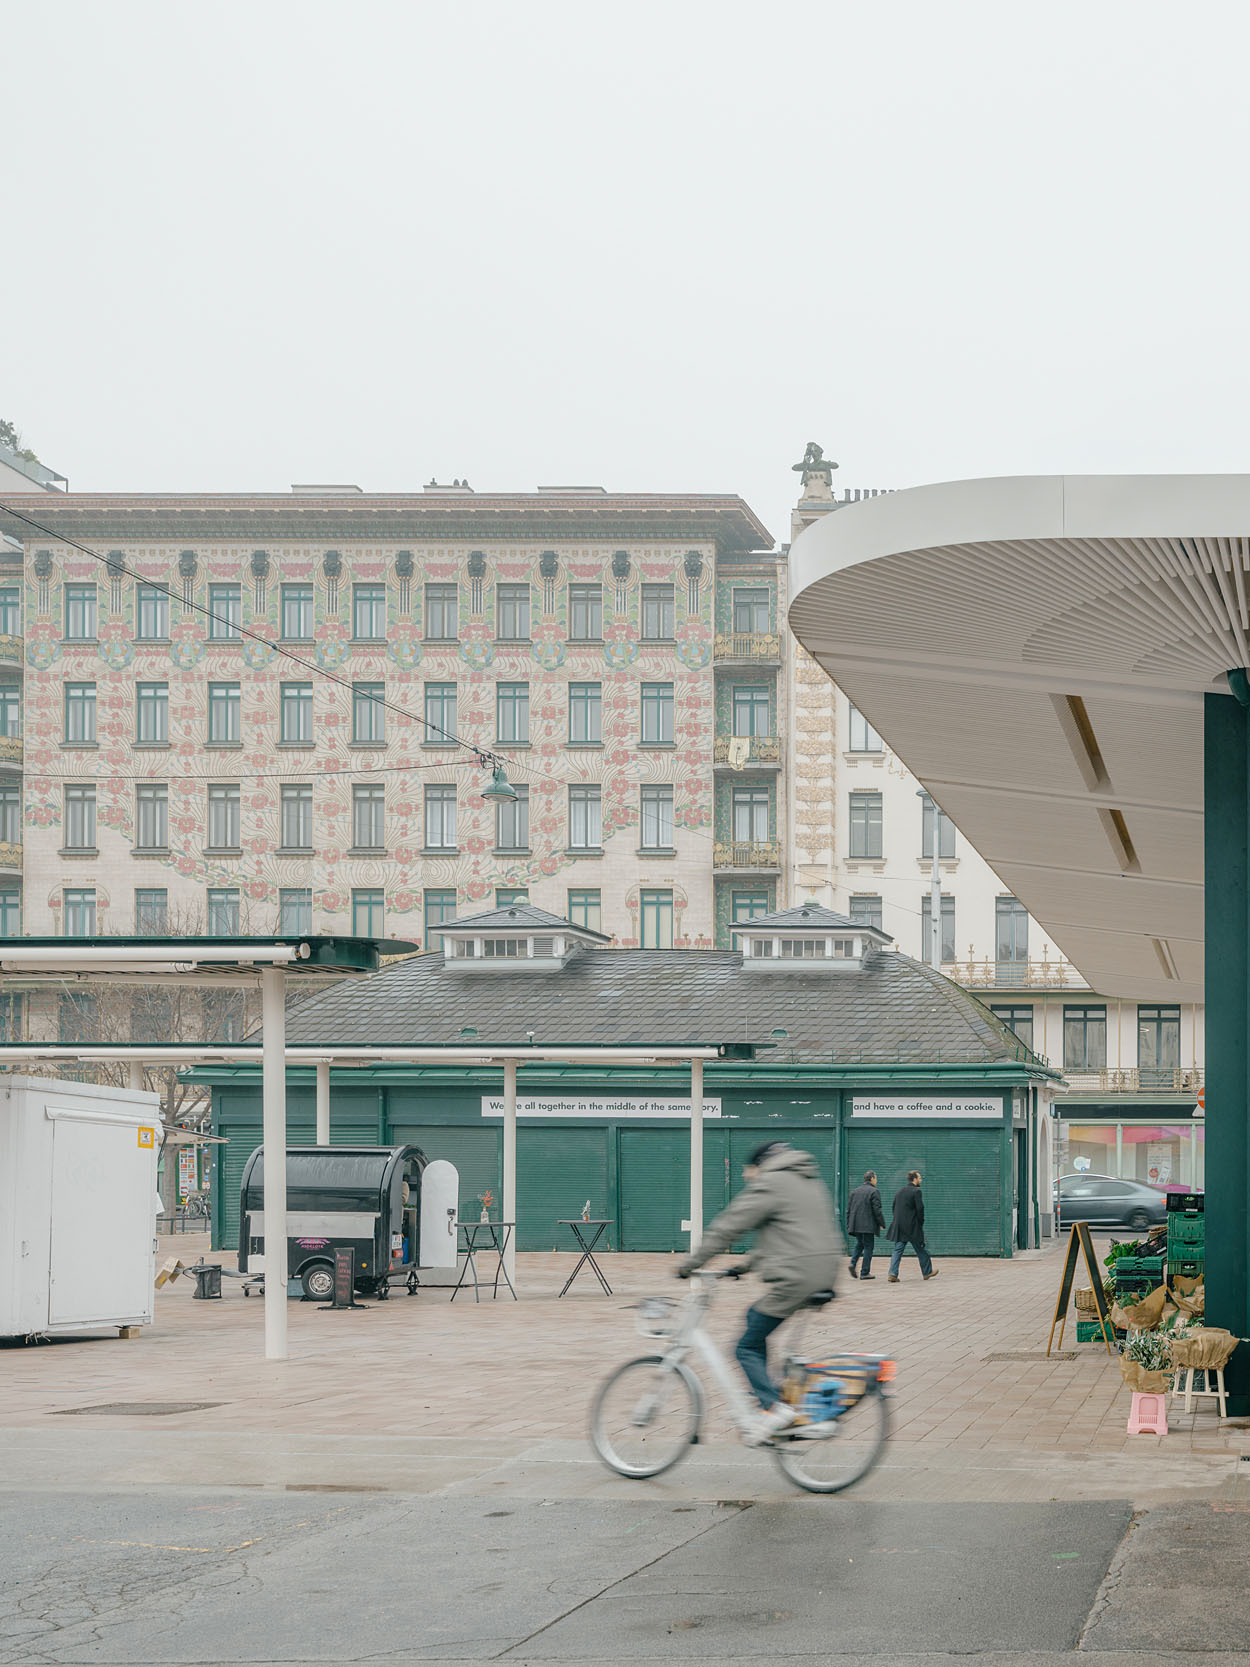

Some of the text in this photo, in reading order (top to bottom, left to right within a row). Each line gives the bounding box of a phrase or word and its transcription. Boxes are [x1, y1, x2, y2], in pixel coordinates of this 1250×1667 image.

[489, 1102, 504, 1110] We
[524, 1101, 536, 1110] all
[538, 1102, 576, 1112] together
[578, 1101, 587, 1110] in
[589, 1102, 603, 1111] the
[606, 1102, 637, 1111] middle
[639, 1102, 649, 1111] of
[651, 1102, 665, 1111] the
[853, 1102, 871, 1111] and
[873, 1102, 895, 1111] have
[897, 1103, 904, 1111] a
[906, 1102, 933, 1111] coffee
[935, 1102, 953, 1111] and
[964, 1102, 996, 1111] cookie.
